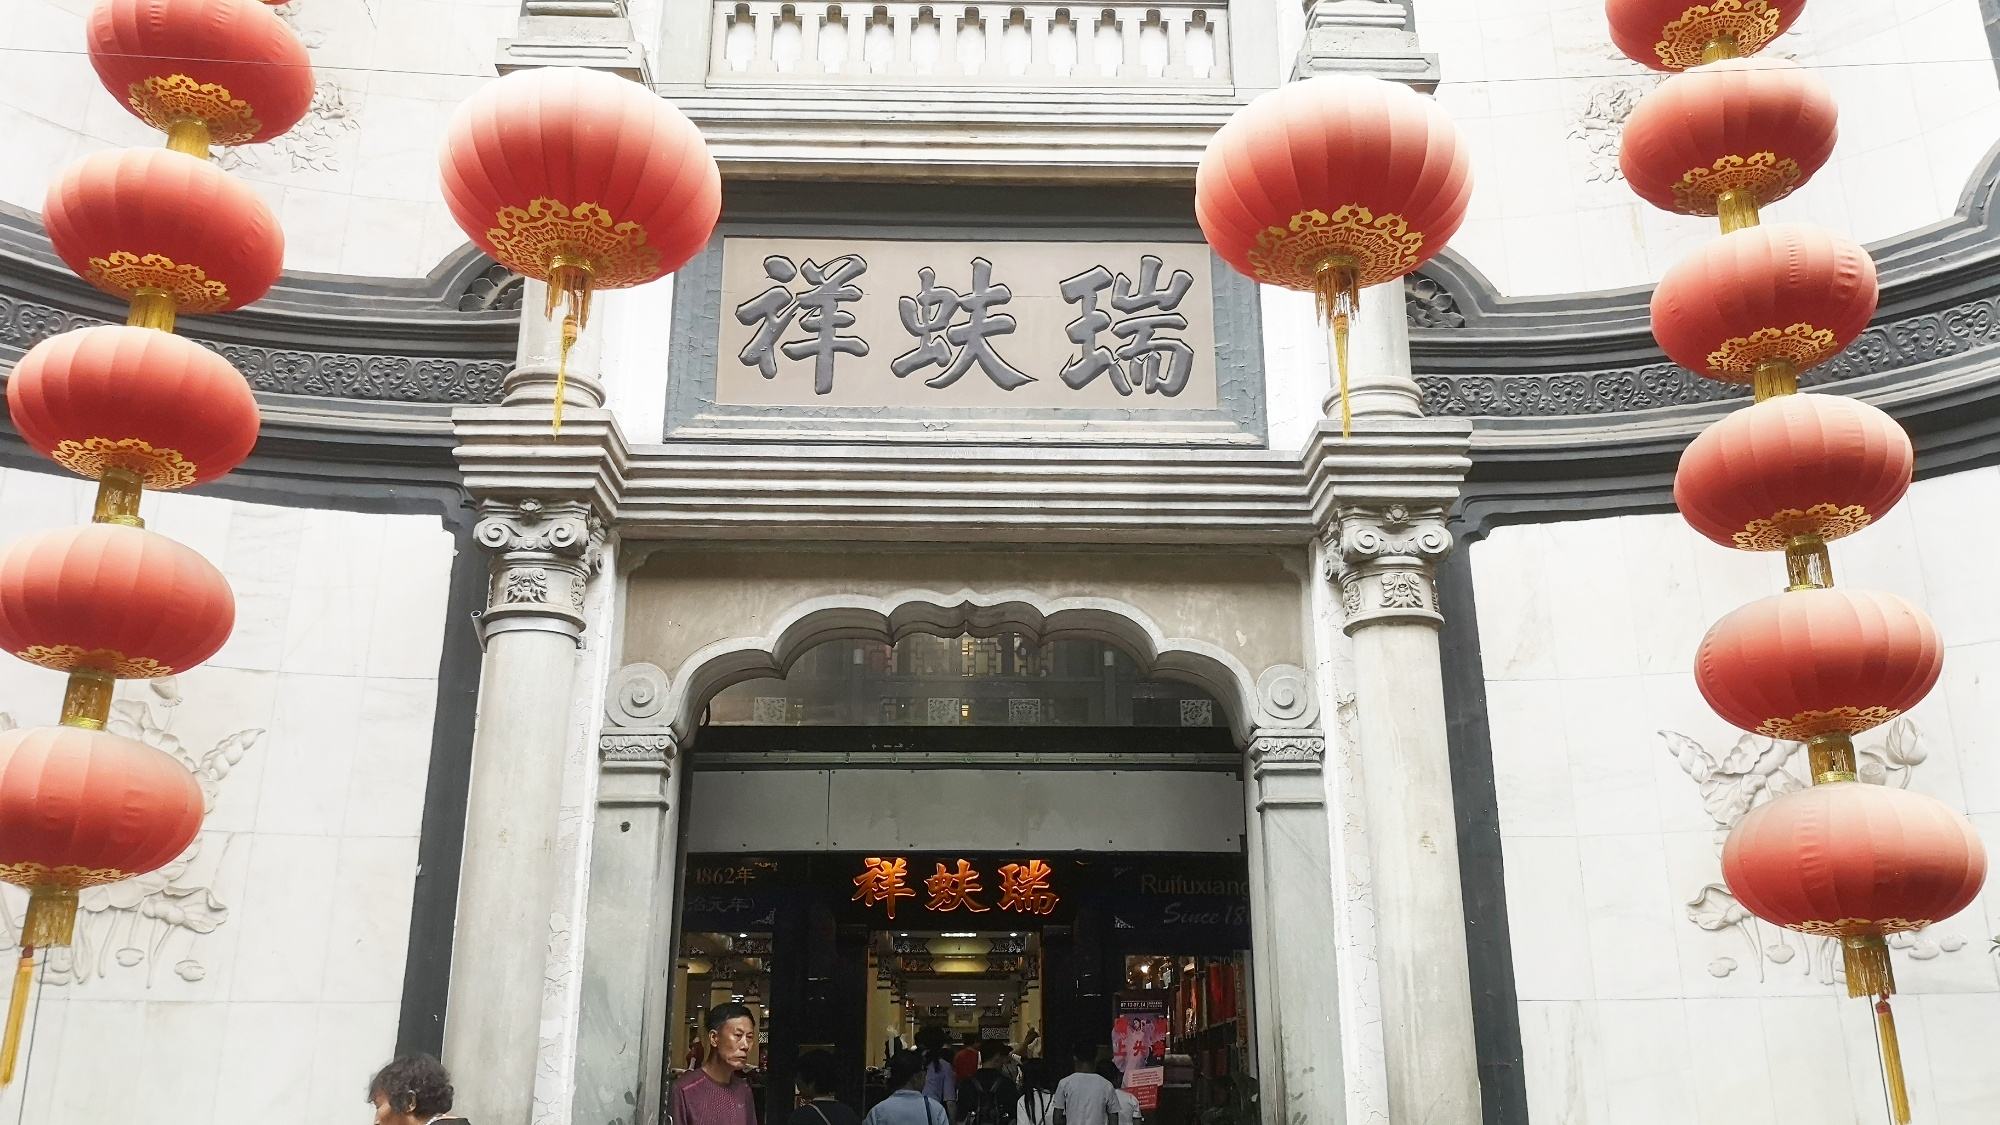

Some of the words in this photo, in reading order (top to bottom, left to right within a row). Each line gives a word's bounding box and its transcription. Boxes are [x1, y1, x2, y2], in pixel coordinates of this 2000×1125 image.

[696, 864, 757, 886] 1862年
[1164, 902, 1218, 924] Since
[1225, 905, 1250, 925] 18
